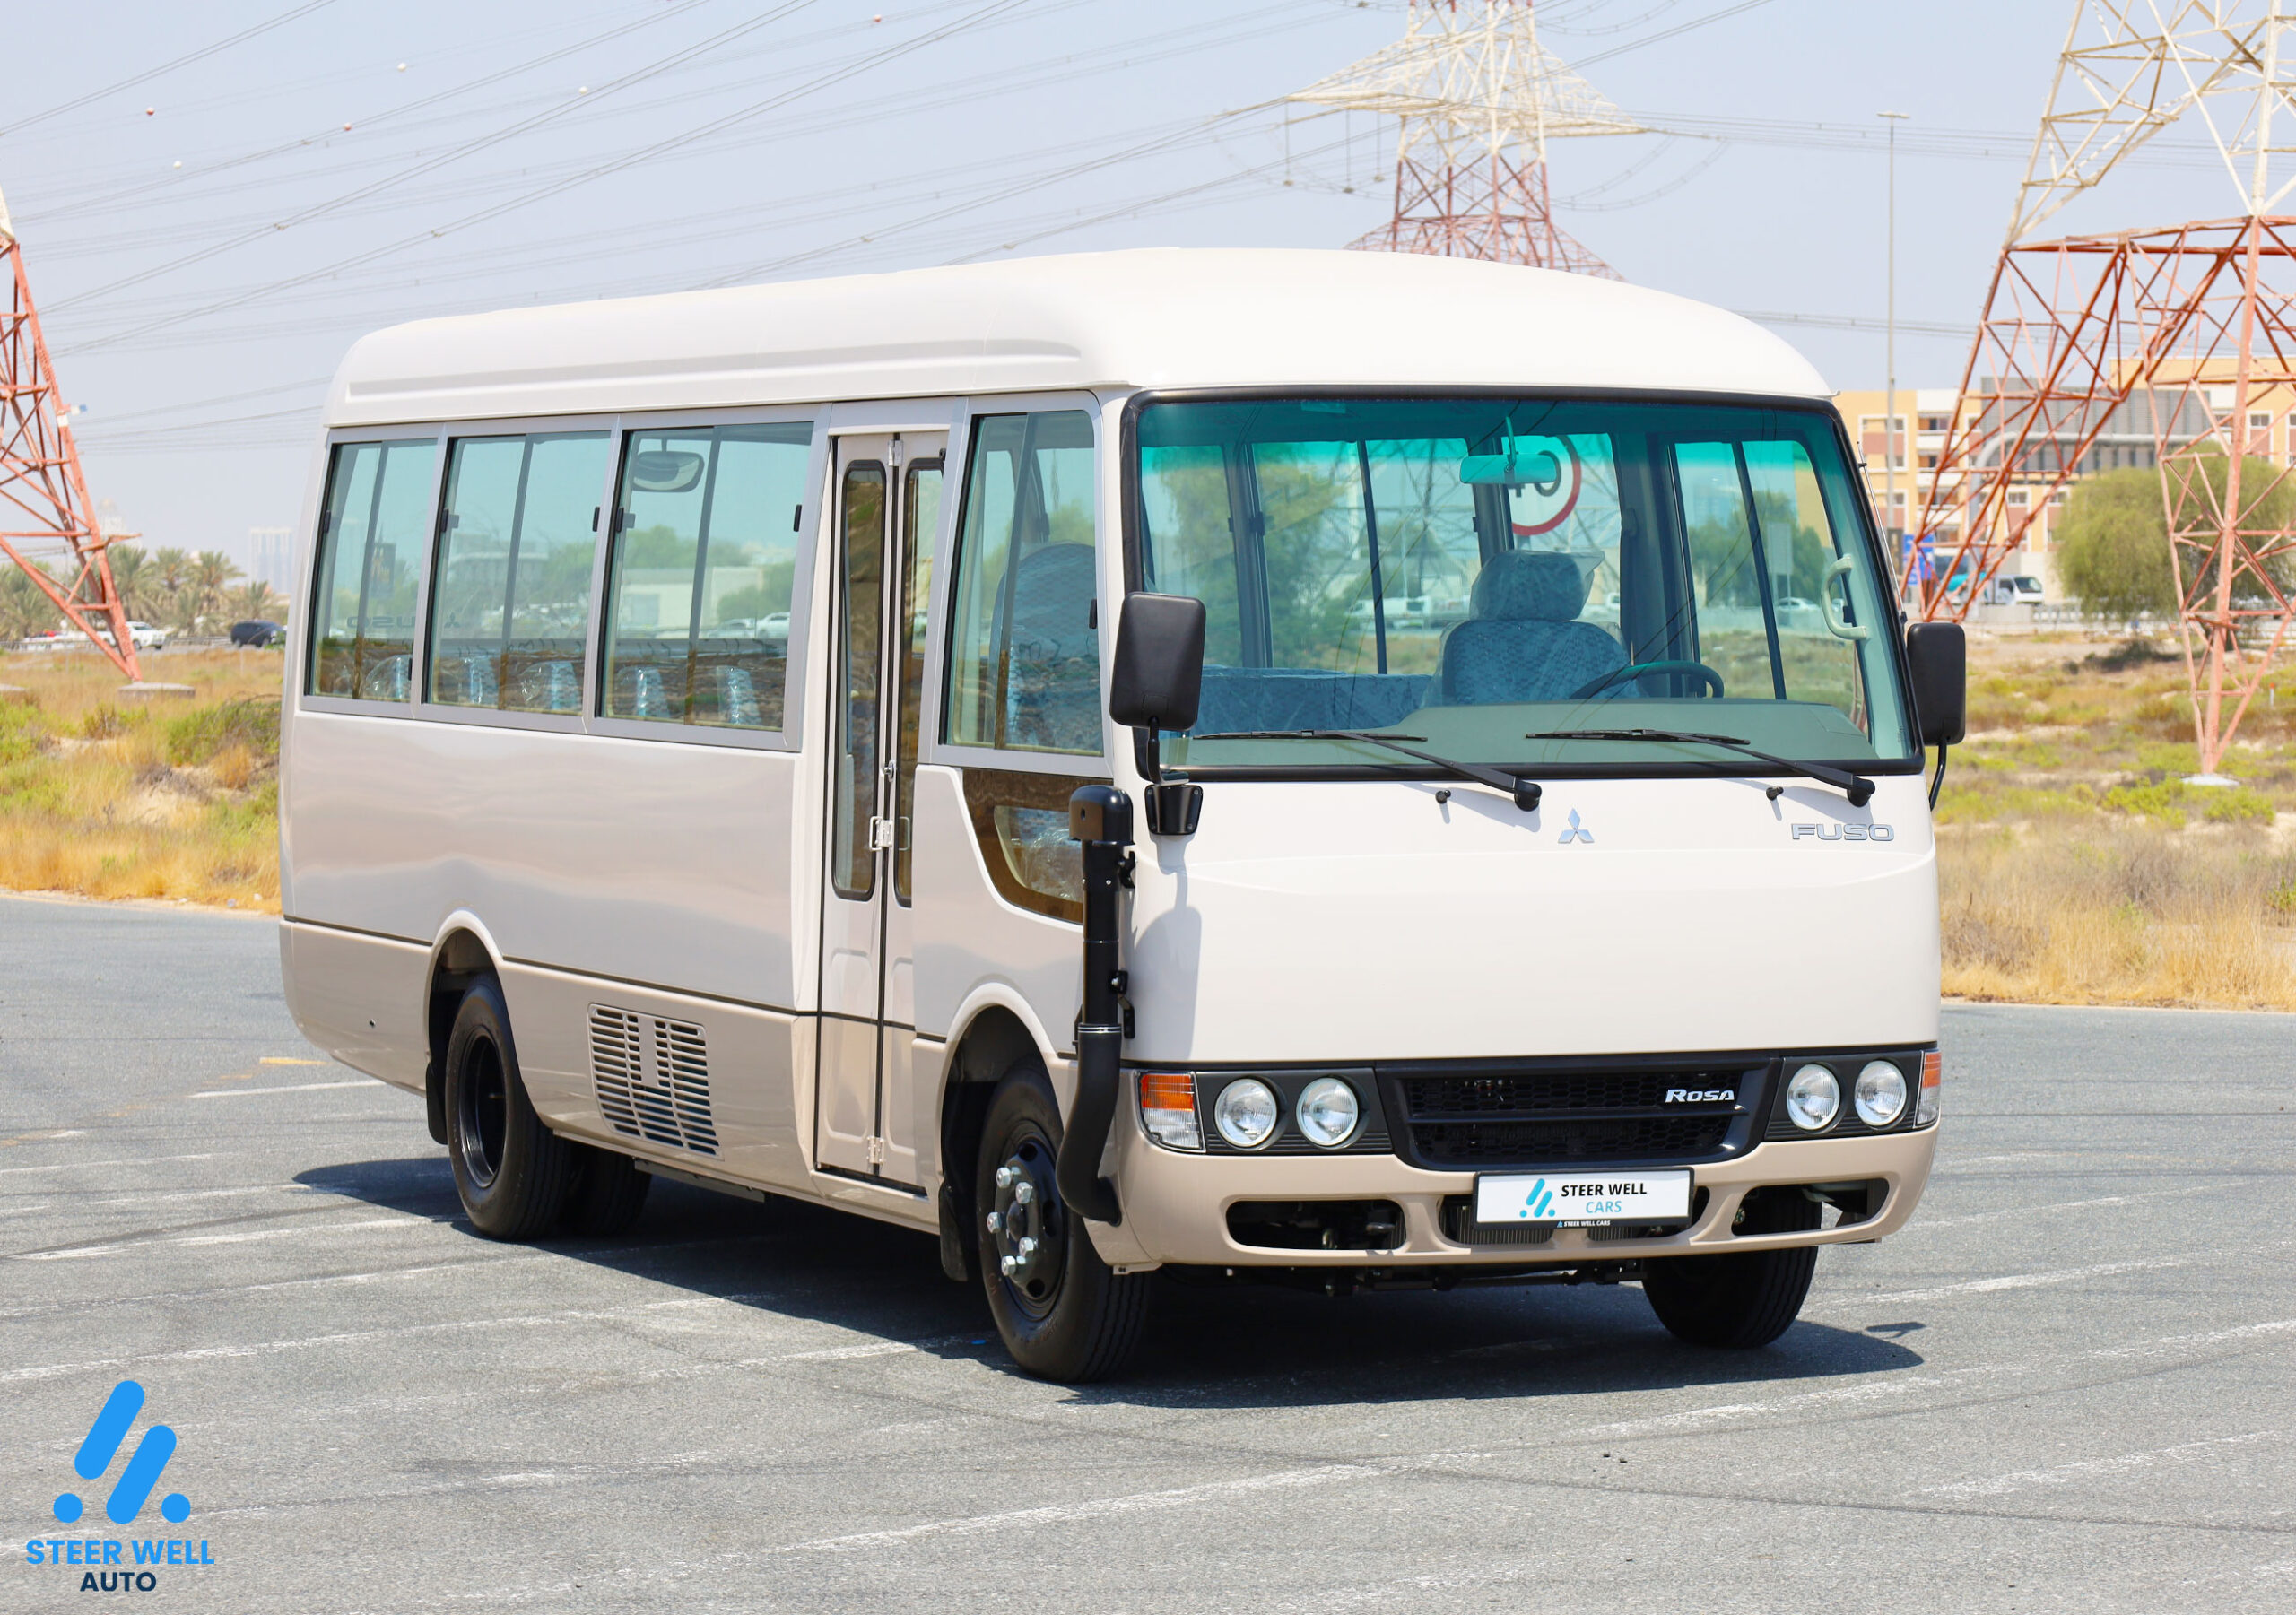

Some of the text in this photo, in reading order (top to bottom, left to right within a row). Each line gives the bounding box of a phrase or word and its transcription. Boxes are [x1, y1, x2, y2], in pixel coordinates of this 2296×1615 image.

[1791, 823, 1894, 841] FUSO
[1561, 1183, 1648, 1197] STEER WELL
[1586, 1200, 1622, 1213] CARS
